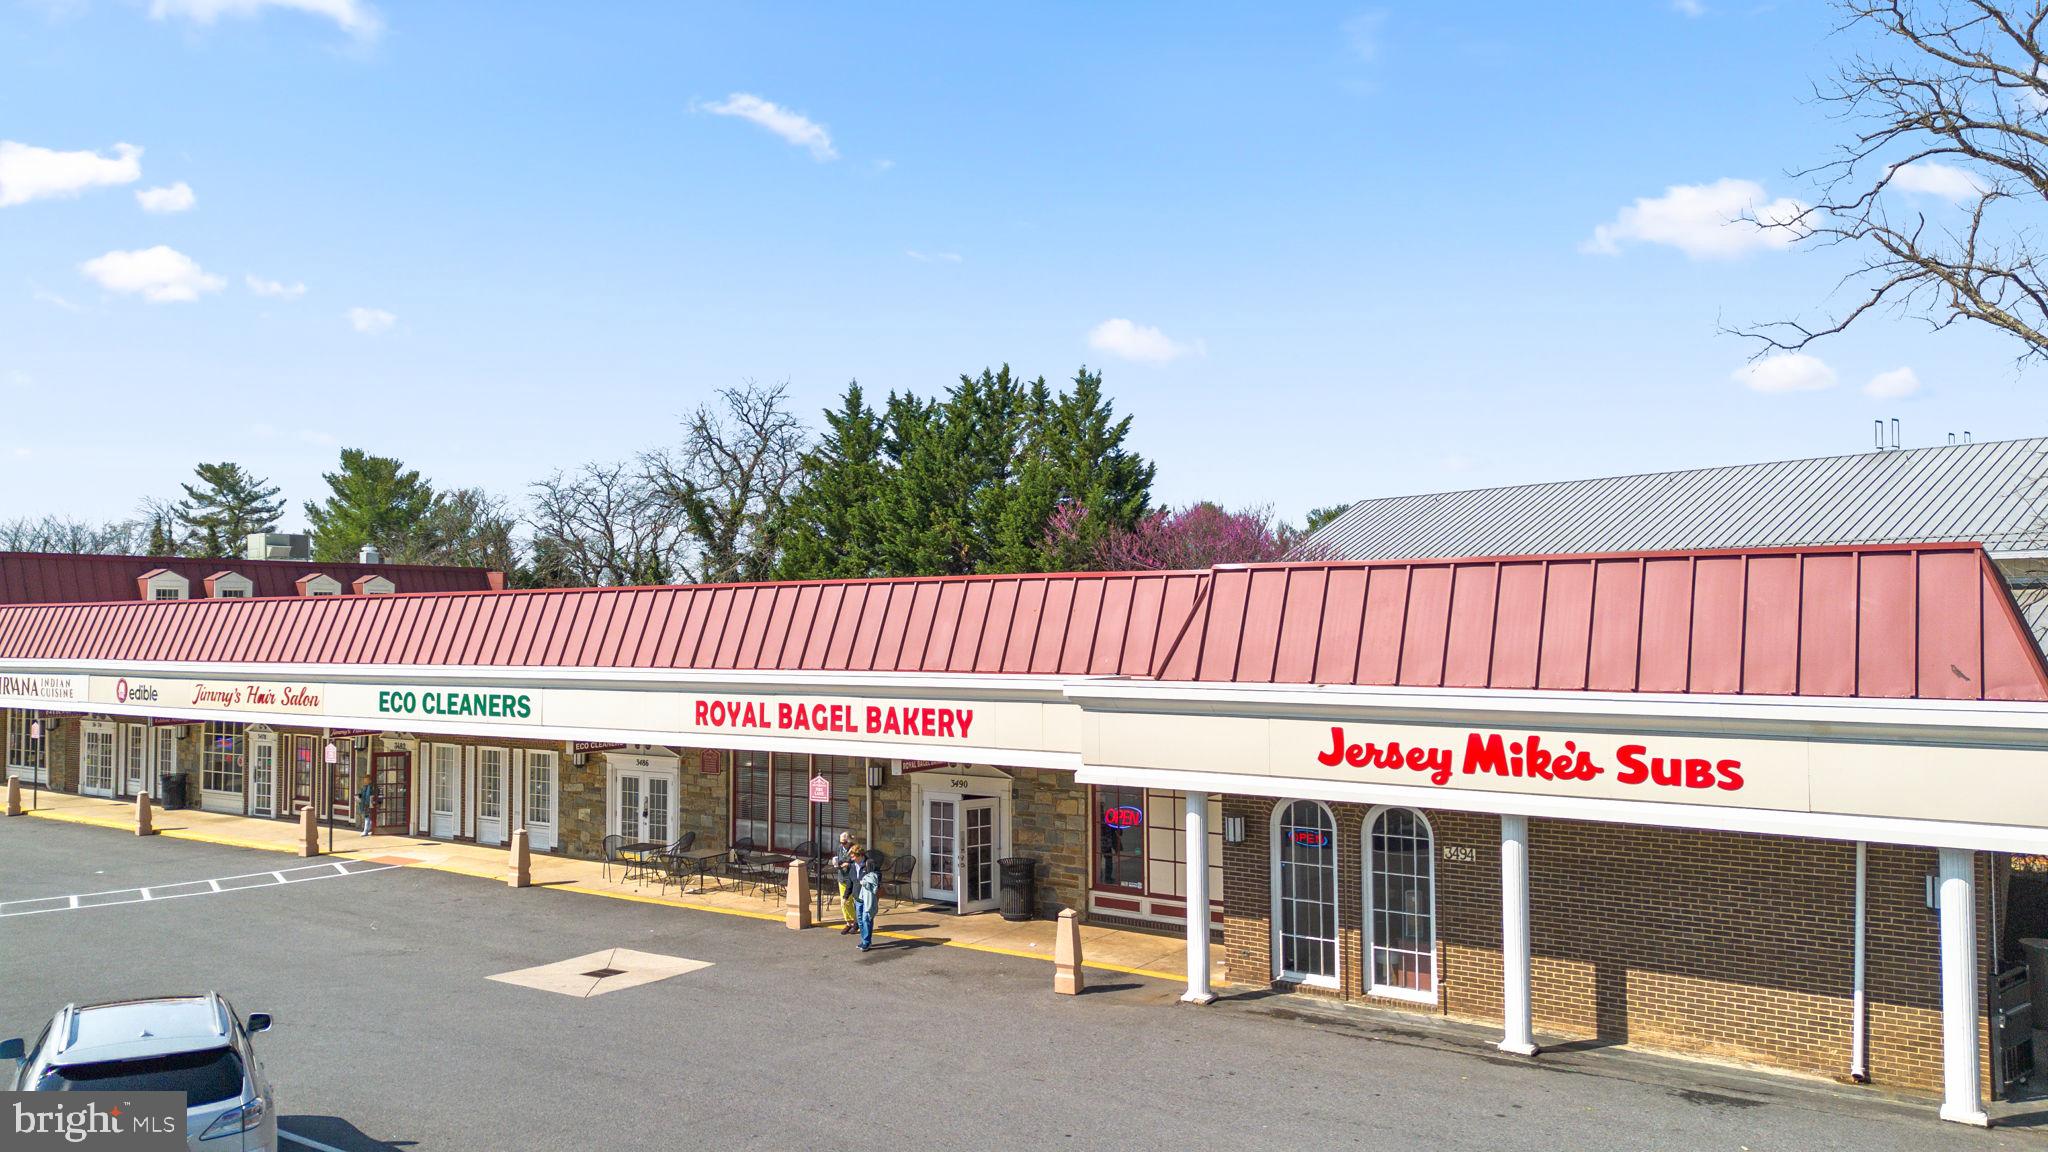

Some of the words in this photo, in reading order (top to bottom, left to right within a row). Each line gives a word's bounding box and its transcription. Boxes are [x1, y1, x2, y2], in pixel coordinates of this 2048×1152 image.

[41, 678, 71, 687] INDIAN
[41, 688, 73, 698] CUISINE
[129, 685, 158, 701] edible
[192, 684, 241, 707] Jimmy's
[246, 685, 276, 705] Hair
[281, 686, 320, 707] Salon
[379, 691, 416, 714] ECO
[422, 692, 531, 718] CLEANERS
[695, 701, 771, 728] ROYAL
[778, 703, 858, 732] BAGEL
[866, 706, 974, 738] BAKERY
[1318, 727, 1453, 785] Jersey
[1462, 733, 1604, 781] Mike's
[951, 780, 968, 788] 3490
[1105, 807, 1140, 827] OPEN
[1445, 847, 1474, 860] 3494
